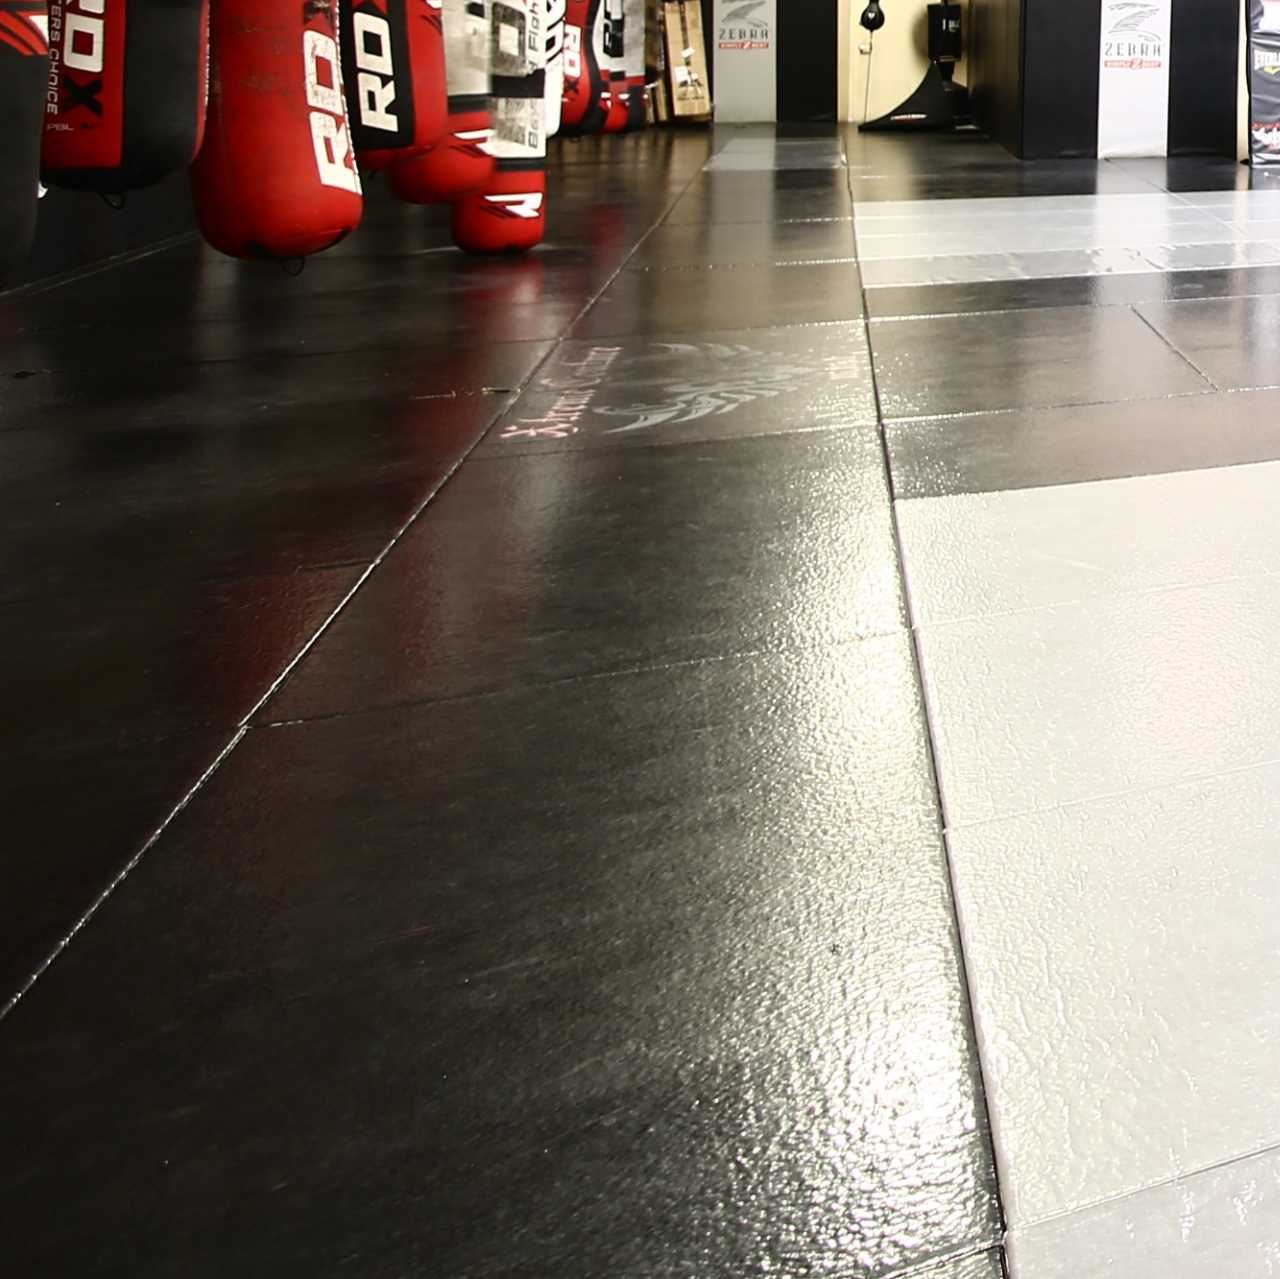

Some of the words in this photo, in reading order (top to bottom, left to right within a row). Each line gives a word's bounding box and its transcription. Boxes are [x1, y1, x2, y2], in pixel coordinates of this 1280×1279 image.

[719, 29, 768, 39] ZEBRA
[1105, 43, 1161, 56] ZEBRA
[47, 47, 61, 116] CHOICE
